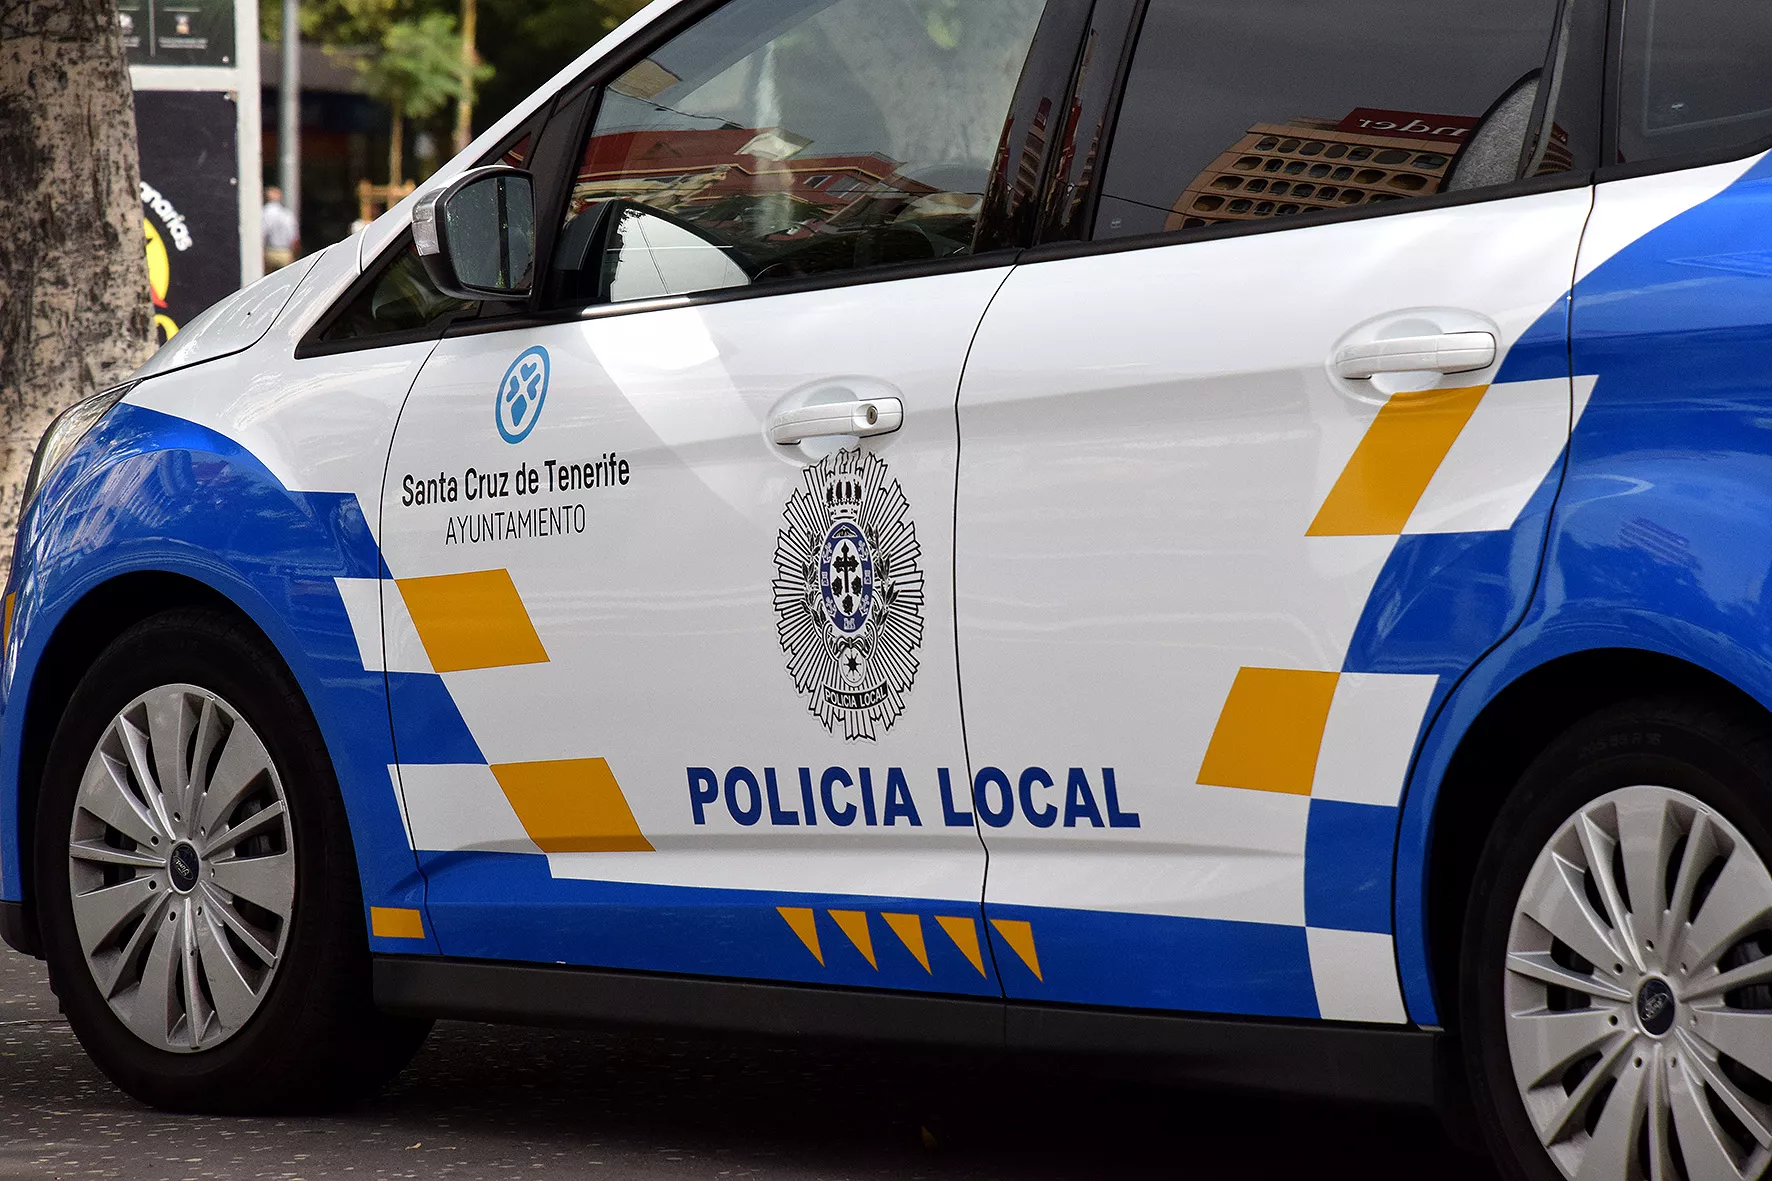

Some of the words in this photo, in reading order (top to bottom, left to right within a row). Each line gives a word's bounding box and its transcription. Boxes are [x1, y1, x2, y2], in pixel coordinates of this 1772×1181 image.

[402, 471, 458, 507] Santa
[464, 467, 509, 501] Cruz
[515, 462, 539, 496] de
[544, 452, 630, 493] Tenerife
[445, 503, 586, 545] AYUNTAMIENTO
[824, 687, 858, 708] POLICIA
[859, 683, 887, 707] LOCAL
[686, 766, 923, 827] POLICIA
[937, 766, 1141, 828] LOCAL
